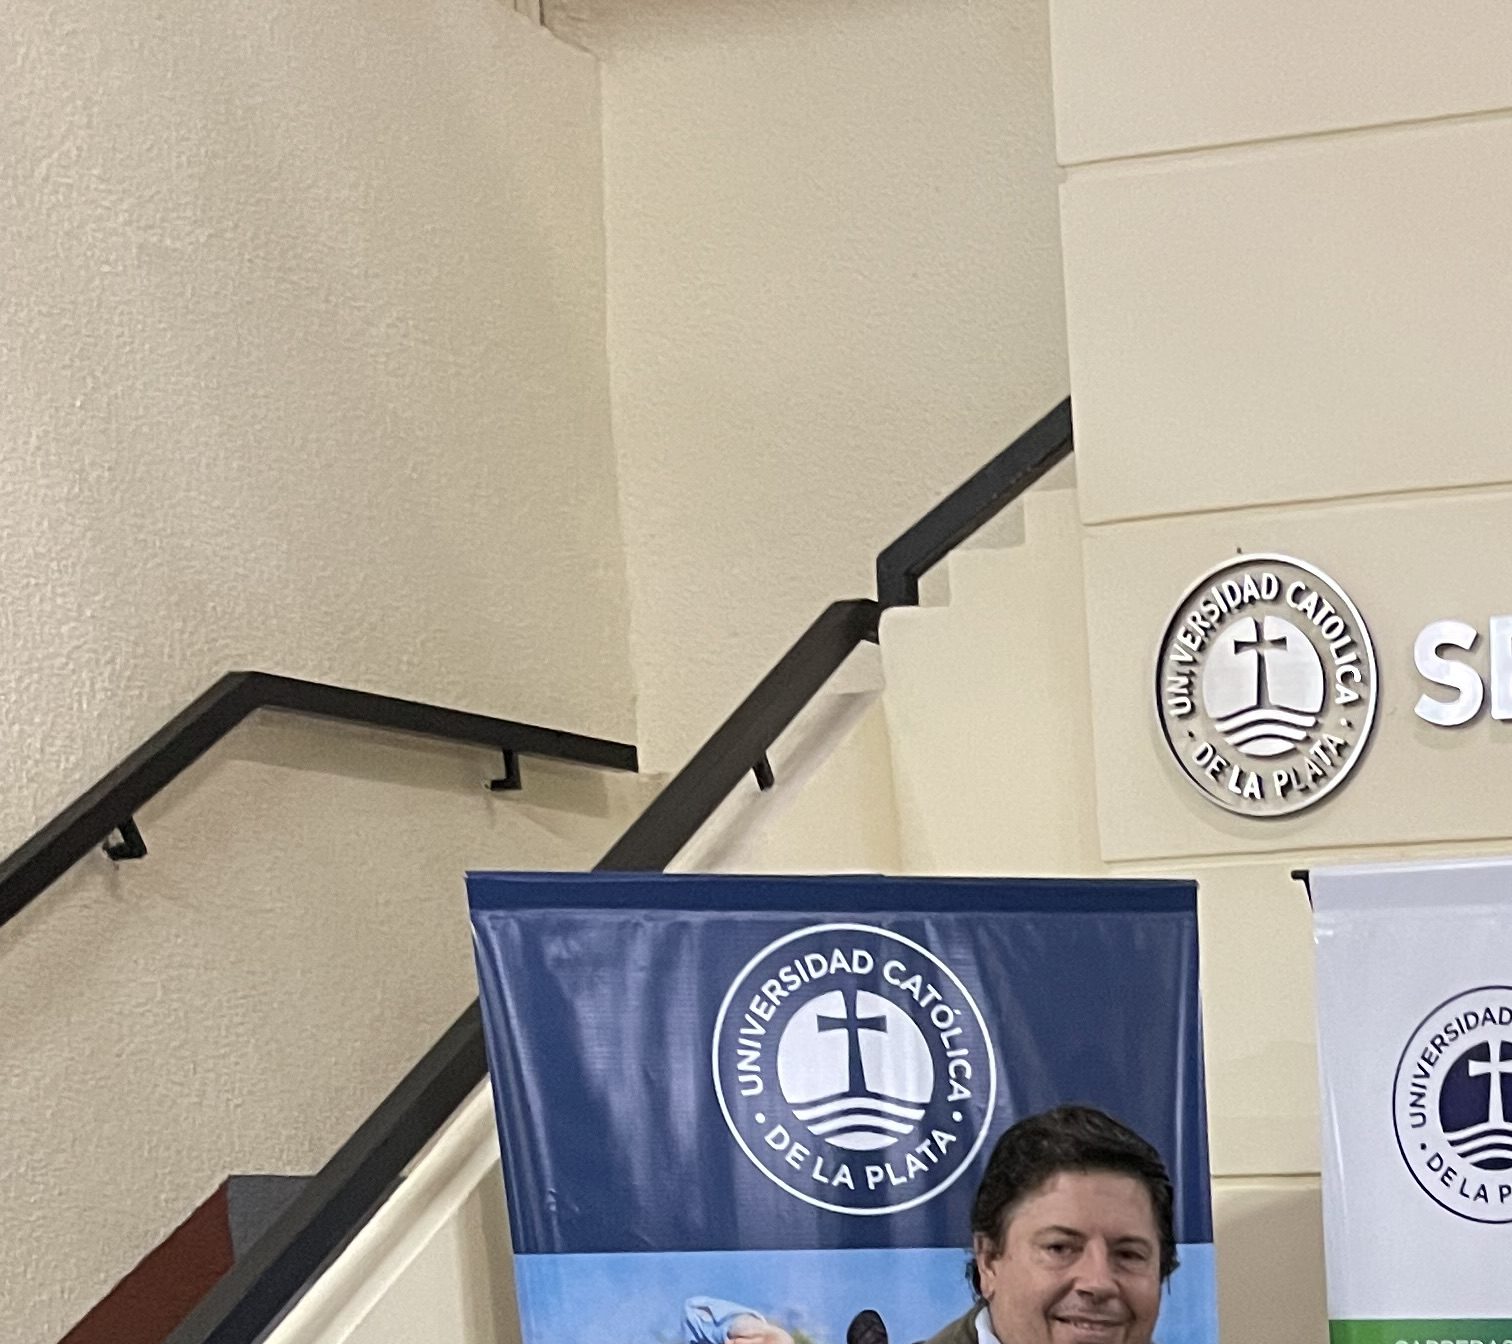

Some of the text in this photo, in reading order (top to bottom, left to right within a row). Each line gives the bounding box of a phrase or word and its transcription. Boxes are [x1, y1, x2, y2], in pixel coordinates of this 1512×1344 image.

[1166, 572, 1281, 718] UNIVERSIDAD
[1192, 733, 1347, 800] DE LA PLATA
[736, 948, 972, 1102] UNIVERSIDAD CATÓLICA
[764, 1124, 957, 1190] DE LA PLATA
[1426, 1151, 1458, 1188] DE
[1459, 1177, 1489, 1204] LA
